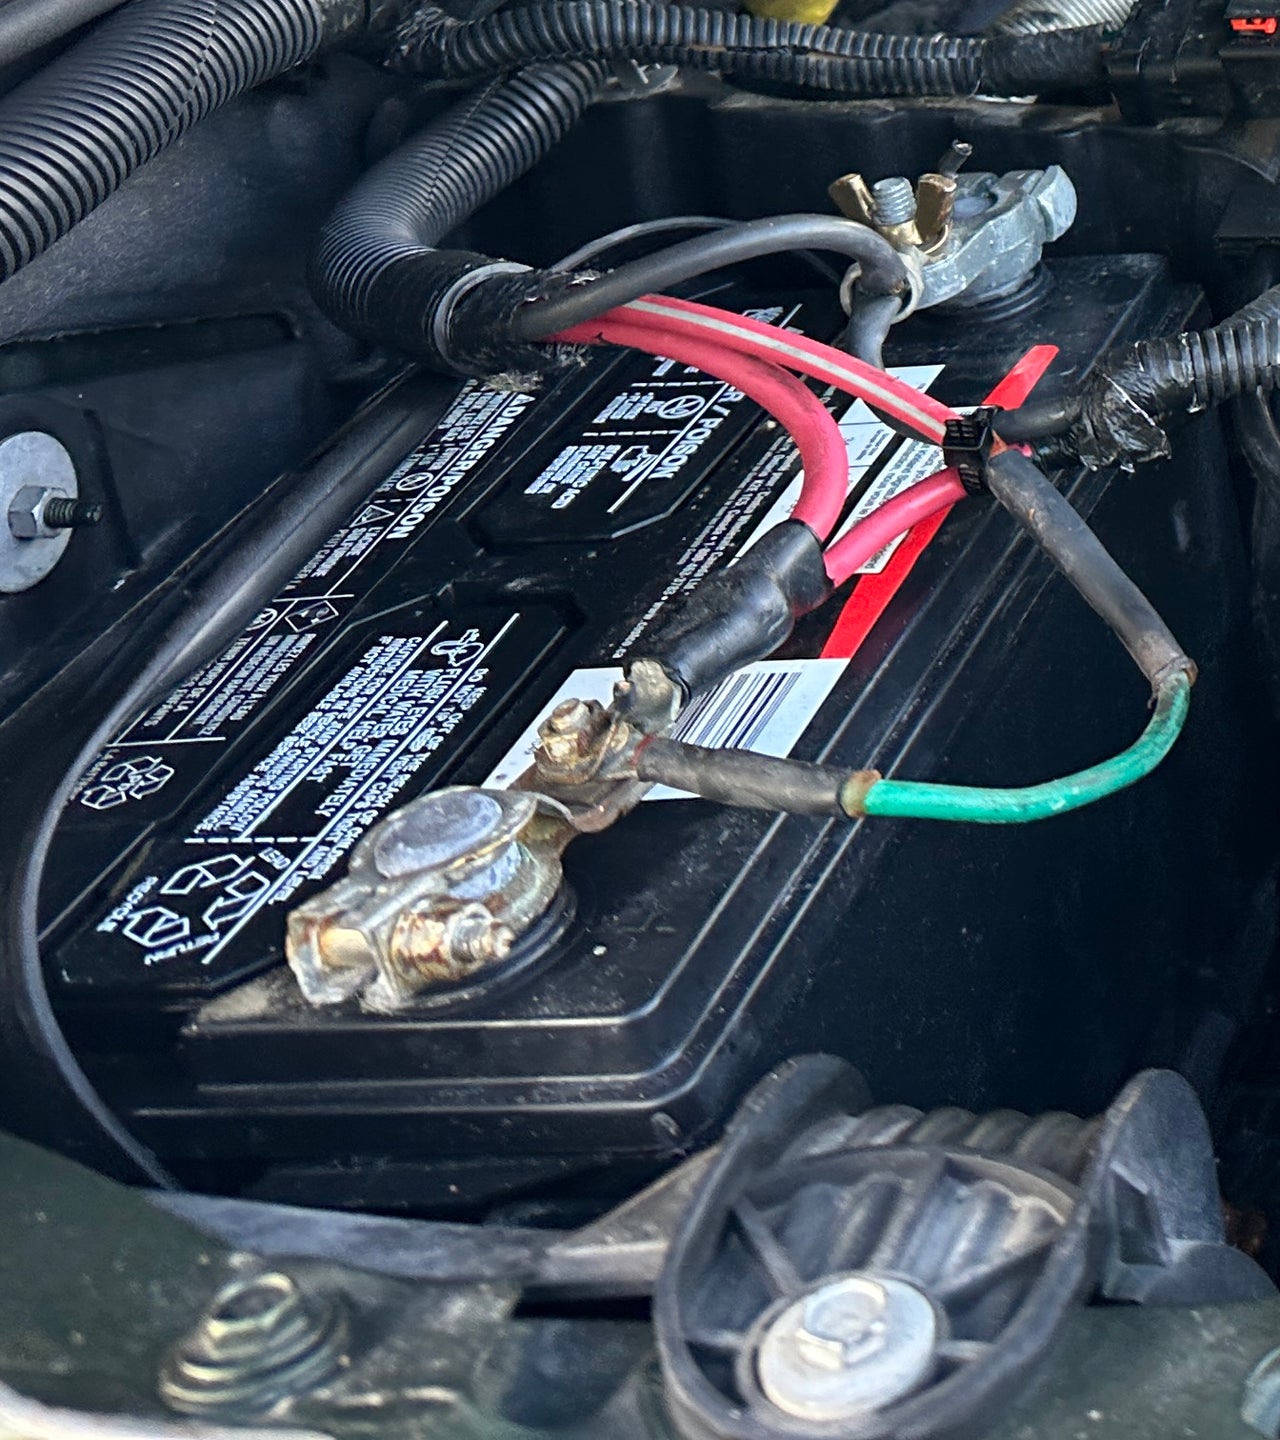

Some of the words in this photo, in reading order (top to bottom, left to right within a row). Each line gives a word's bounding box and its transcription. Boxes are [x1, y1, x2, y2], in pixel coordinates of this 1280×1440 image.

[648, 418, 723, 479] POISON
[386, 405, 525, 539] DANGER/POISON
[336, 638, 407, 699] INSTRUCTIONS
[360, 646, 384, 664] NOT
[315, 666, 364, 710] AVAILABLE
[355, 677, 386, 695] FOR
[405, 669, 444, 697] WITH
[414, 668, 462, 704] FLUSH
[468, 668, 489, 682] DO
[326, 699, 349, 710] IN
[366, 670, 423, 718] MEDICAL
[450, 685, 475, 703] NOT
[460, 687, 487, 710] KEEP
[331, 697, 367, 720] SAFE
[385, 706, 428, 735] EYES
[290, 712, 338, 747] VEHICLE
[291, 712, 322, 734] SEEK
[307, 720, 343, 745] JUMP
[340, 721, 377, 750] HELP
[434, 713, 463, 734] OUT
[254, 736, 299, 772] SERVICE
[340, 745, 372, 768] GET
[423, 736, 444, 750] OF
[268, 747, 320, 790] STARTING
[306, 754, 348, 782] FAST
[382, 755, 414, 780] VENT
[402, 752, 431, 772] THE
[315, 740, 399, 817] IMMEDIATELY
[371, 774, 411, 807] REACH
[354, 782, 387, 809] CAPS
[229, 793, 275, 832] FOLLOW
[358, 810, 378, 825] OF
[325, 812, 363, 843] TIGHT
[302, 846, 330, 869] AND
[307, 827, 363, 879] CHILDREN
[97, 877, 158, 932] RECYCLE
